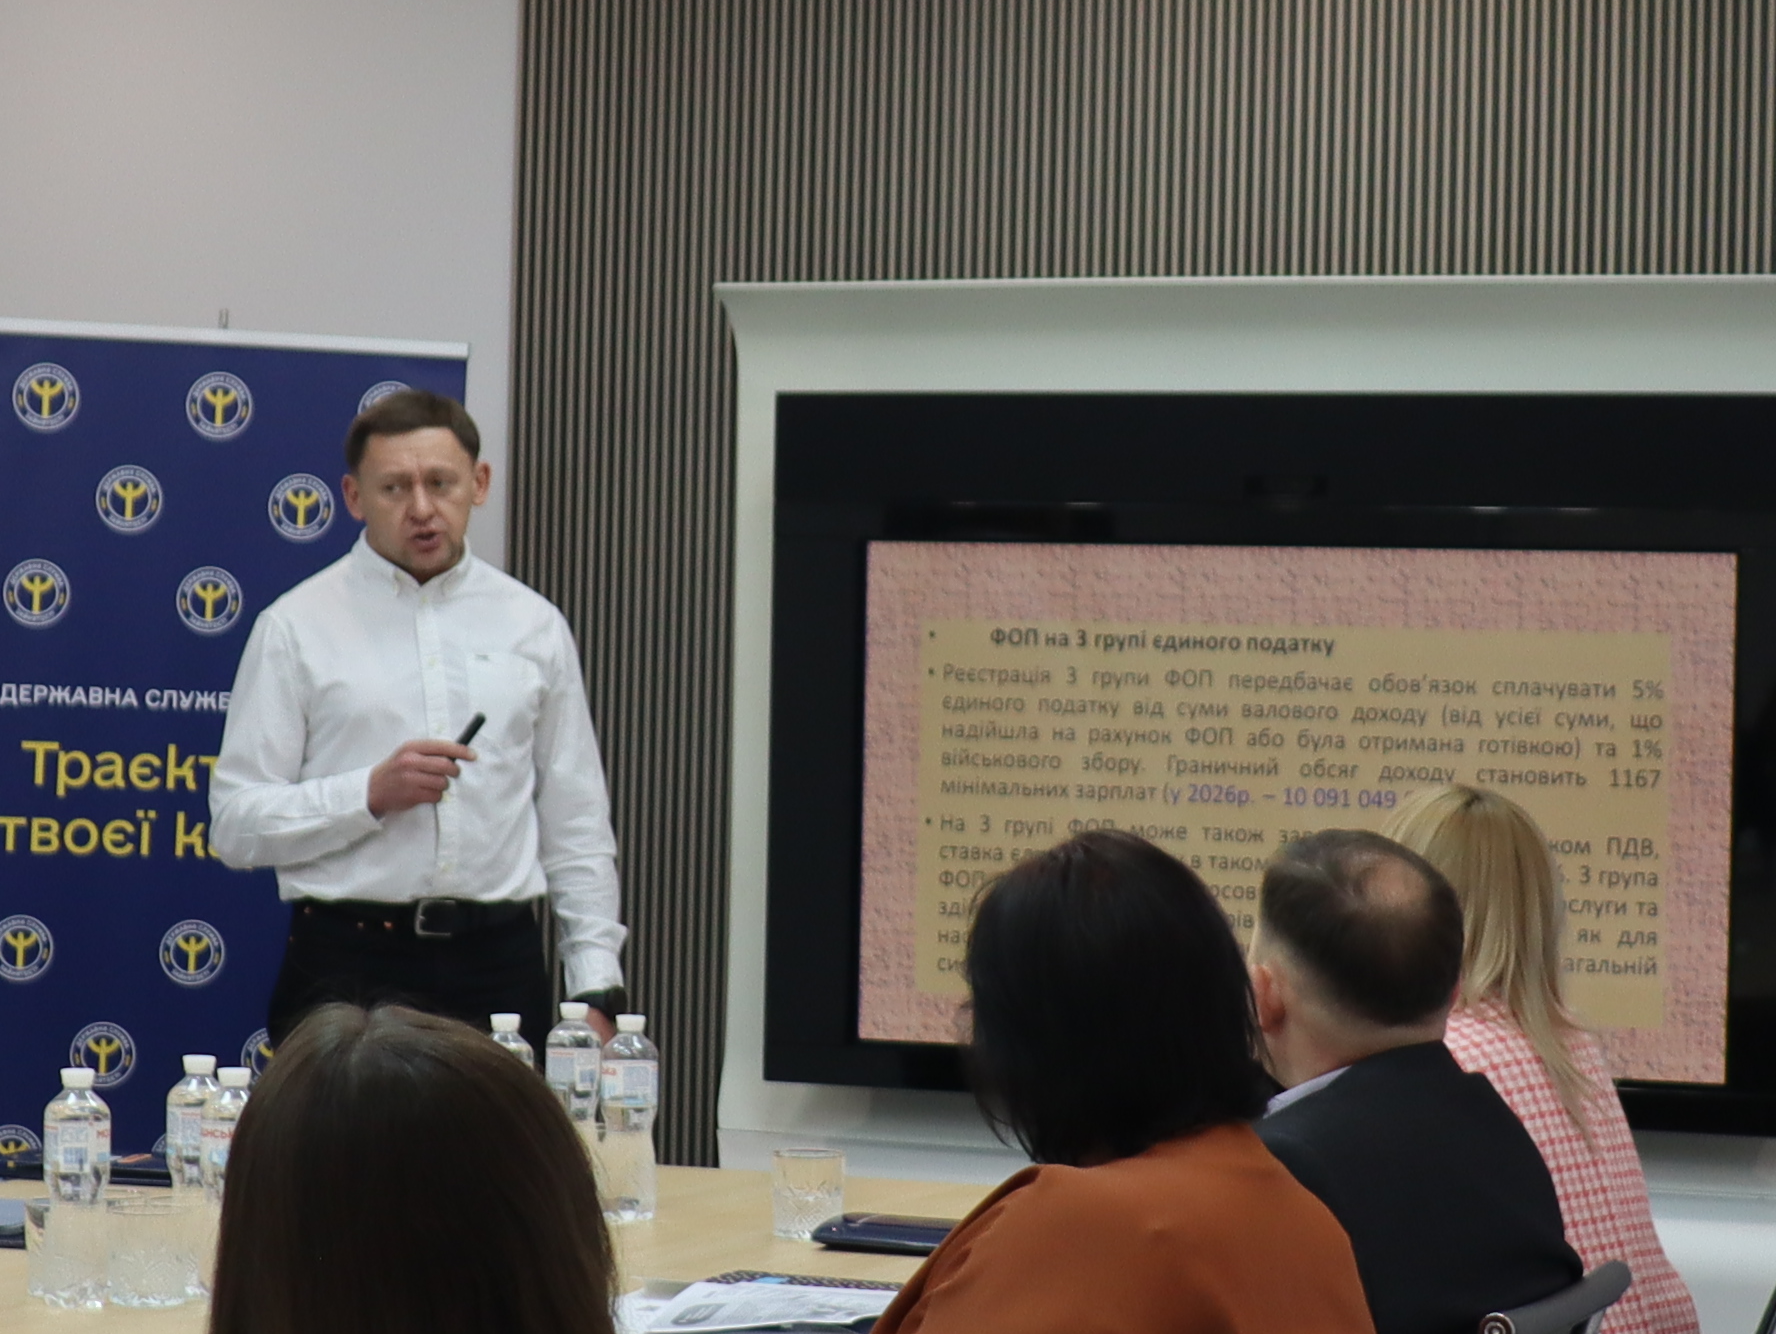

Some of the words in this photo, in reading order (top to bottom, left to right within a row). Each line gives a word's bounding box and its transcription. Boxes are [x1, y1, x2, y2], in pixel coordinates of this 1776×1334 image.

[990, 628, 1039, 647] ФОП
[1045, 633, 1069, 647] на
[1076, 630, 1087, 647] 3
[1094, 630, 1147, 652] групі
[1152, 634, 1241, 653] єдиного
[1246, 635, 1335, 656] податку
[144, 688, 232, 712] СЛУЖБ
[941, 664, 1051, 687] Реєстрація
[1066, 667, 1078, 684] 3
[1091, 669, 1150, 690] групи
[1164, 669, 1213, 688] ФОП
[1228, 672, 1353, 694] передбачає
[1491, 680, 1617, 701] сплачувати
[1631, 679, 1664, 700] 5%
[941, 696, 1025, 715] єдиного
[1038, 698, 1119, 718] податку
[1133, 699, 1165, 718] від
[1177, 702, 1229, 720] суми
[1240, 704, 1339, 721] валового
[1351, 707, 1428, 727] доходу
[1441, 705, 1483, 728] (від
[1495, 709, 1541, 728] усієї
[1554, 712, 1616, 732] суми,
[1630, 714, 1664, 733] що
[941, 723, 1040, 742] надійшла
[1052, 727, 1076, 742] на
[1087, 728, 1172, 746] рахунок
[1184, 727, 1234, 746] ФОП
[1246, 728, 1284, 747] або
[1297, 730, 1347, 752] була
[1358, 735, 1465, 754] отримана
[1477, 736, 1582, 758] готівкою)
[1594, 741, 1617, 757] та
[1631, 740, 1664, 760] 1%
[941, 750, 1062, 769] військового
[1081, 750, 1146, 774] збору.
[1167, 754, 1280, 776] Граничний
[1299, 758, 1360, 780] обсяг
[1378, 765, 1455, 785] доходу
[1475, 768, 1588, 788] становить
[1609, 768, 1662, 789] 1167
[940, 777, 1070, 798] мінімальних
[1075, 783, 1158, 803] зарплат
[1186, 784, 1255, 809] 2026р.
[1283, 787, 1308, 806] 10
[1312, 787, 1352, 808] 091
[1357, 788, 1398, 810] 049
[940, 817, 965, 833] На
[979, 817, 991, 834] 3
[1004, 818, 1054, 838] групі
[1130, 823, 1188, 841] може
[1202, 827, 1265, 844] також
[1605, 836, 1660, 861] ПДВ,
[939, 844, 1003, 862] ставка
[1191, 856, 1202, 869] в
[1207, 855, 1269, 872] таком
[1579, 865, 1592, 885] 3
[1598, 870, 1659, 890] група
[1636, 900, 1659, 917] та
[1577, 927, 1602, 944] як
[1616, 929, 1659, 949] для
[1562, 955, 1658, 976] агальній
